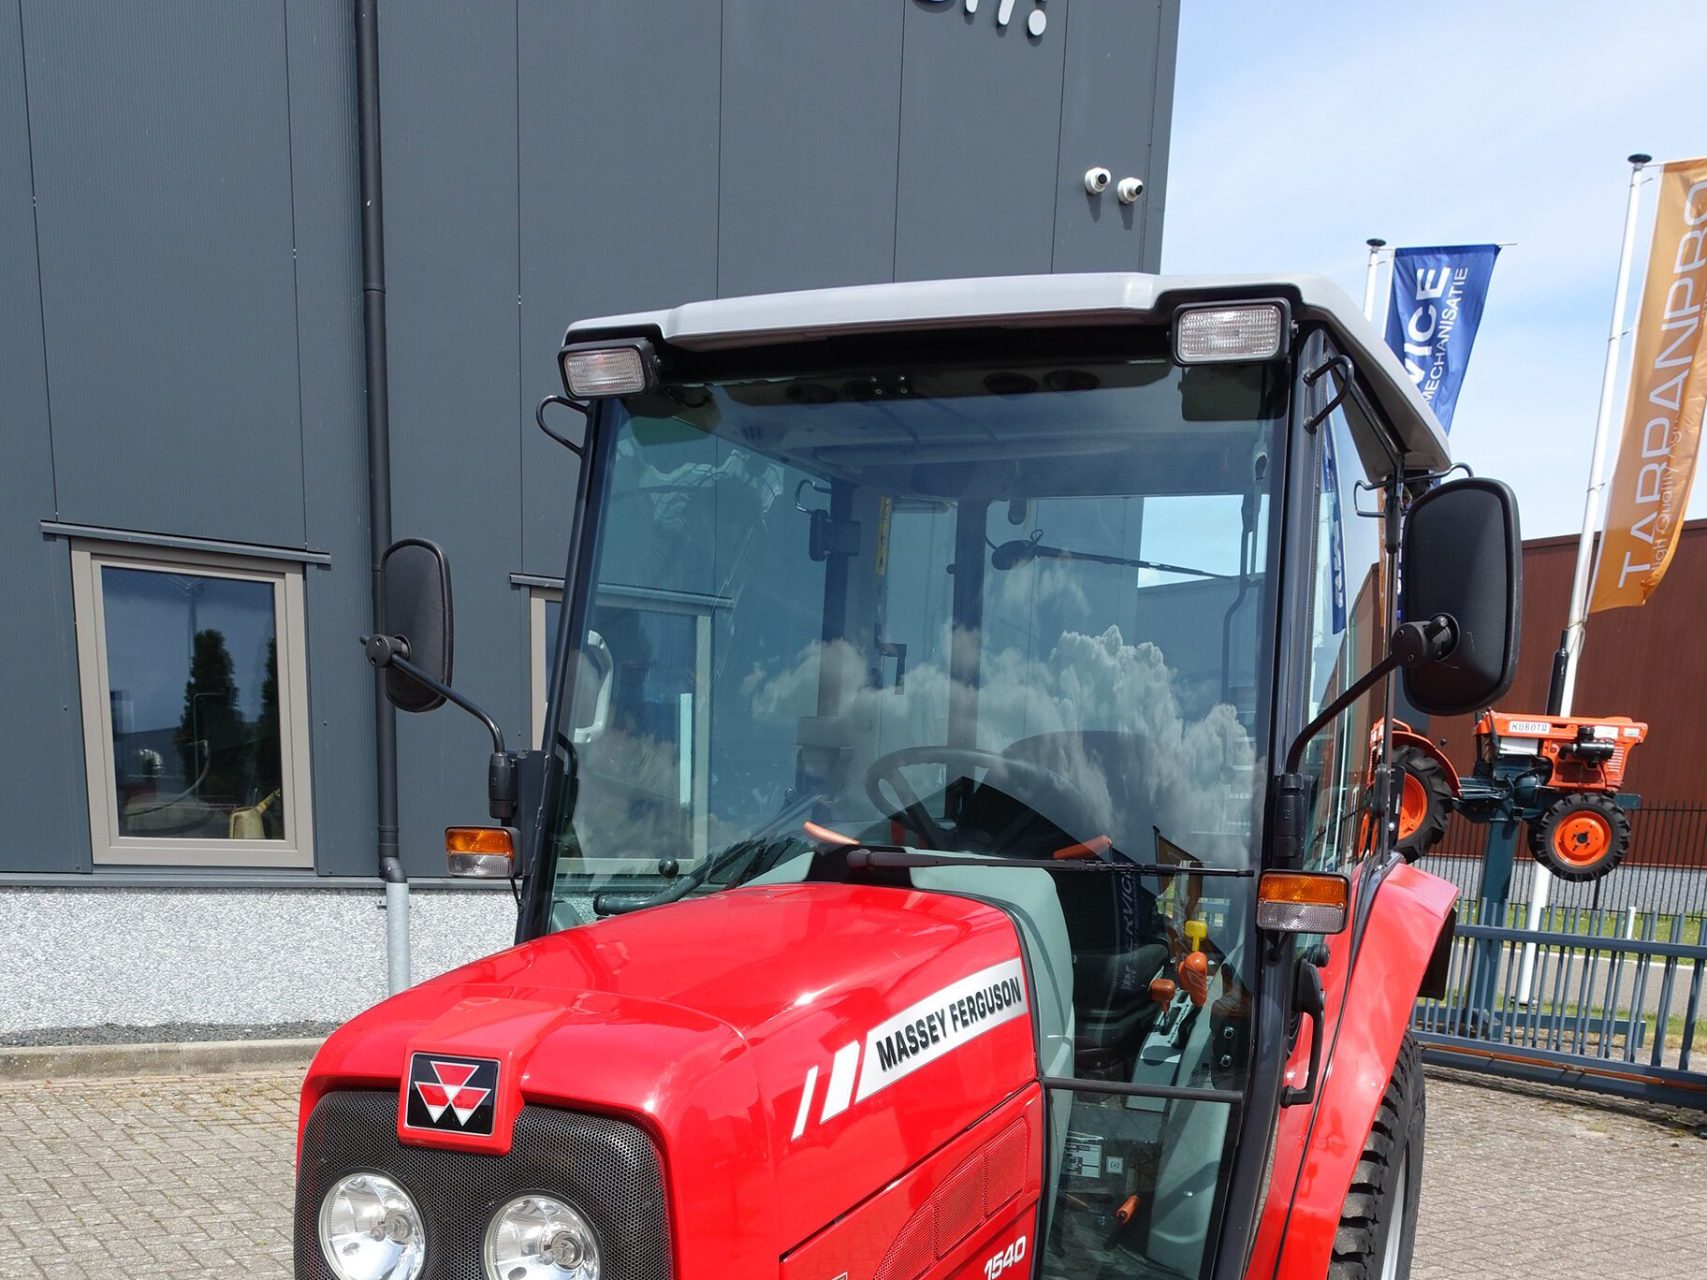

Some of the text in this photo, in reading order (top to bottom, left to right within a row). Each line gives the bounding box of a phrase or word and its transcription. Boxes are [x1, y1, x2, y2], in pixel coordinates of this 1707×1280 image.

[1511, 722, 1548, 732] KUBOTA
[876, 976, 1022, 1072] MASSEY FERGUSON
